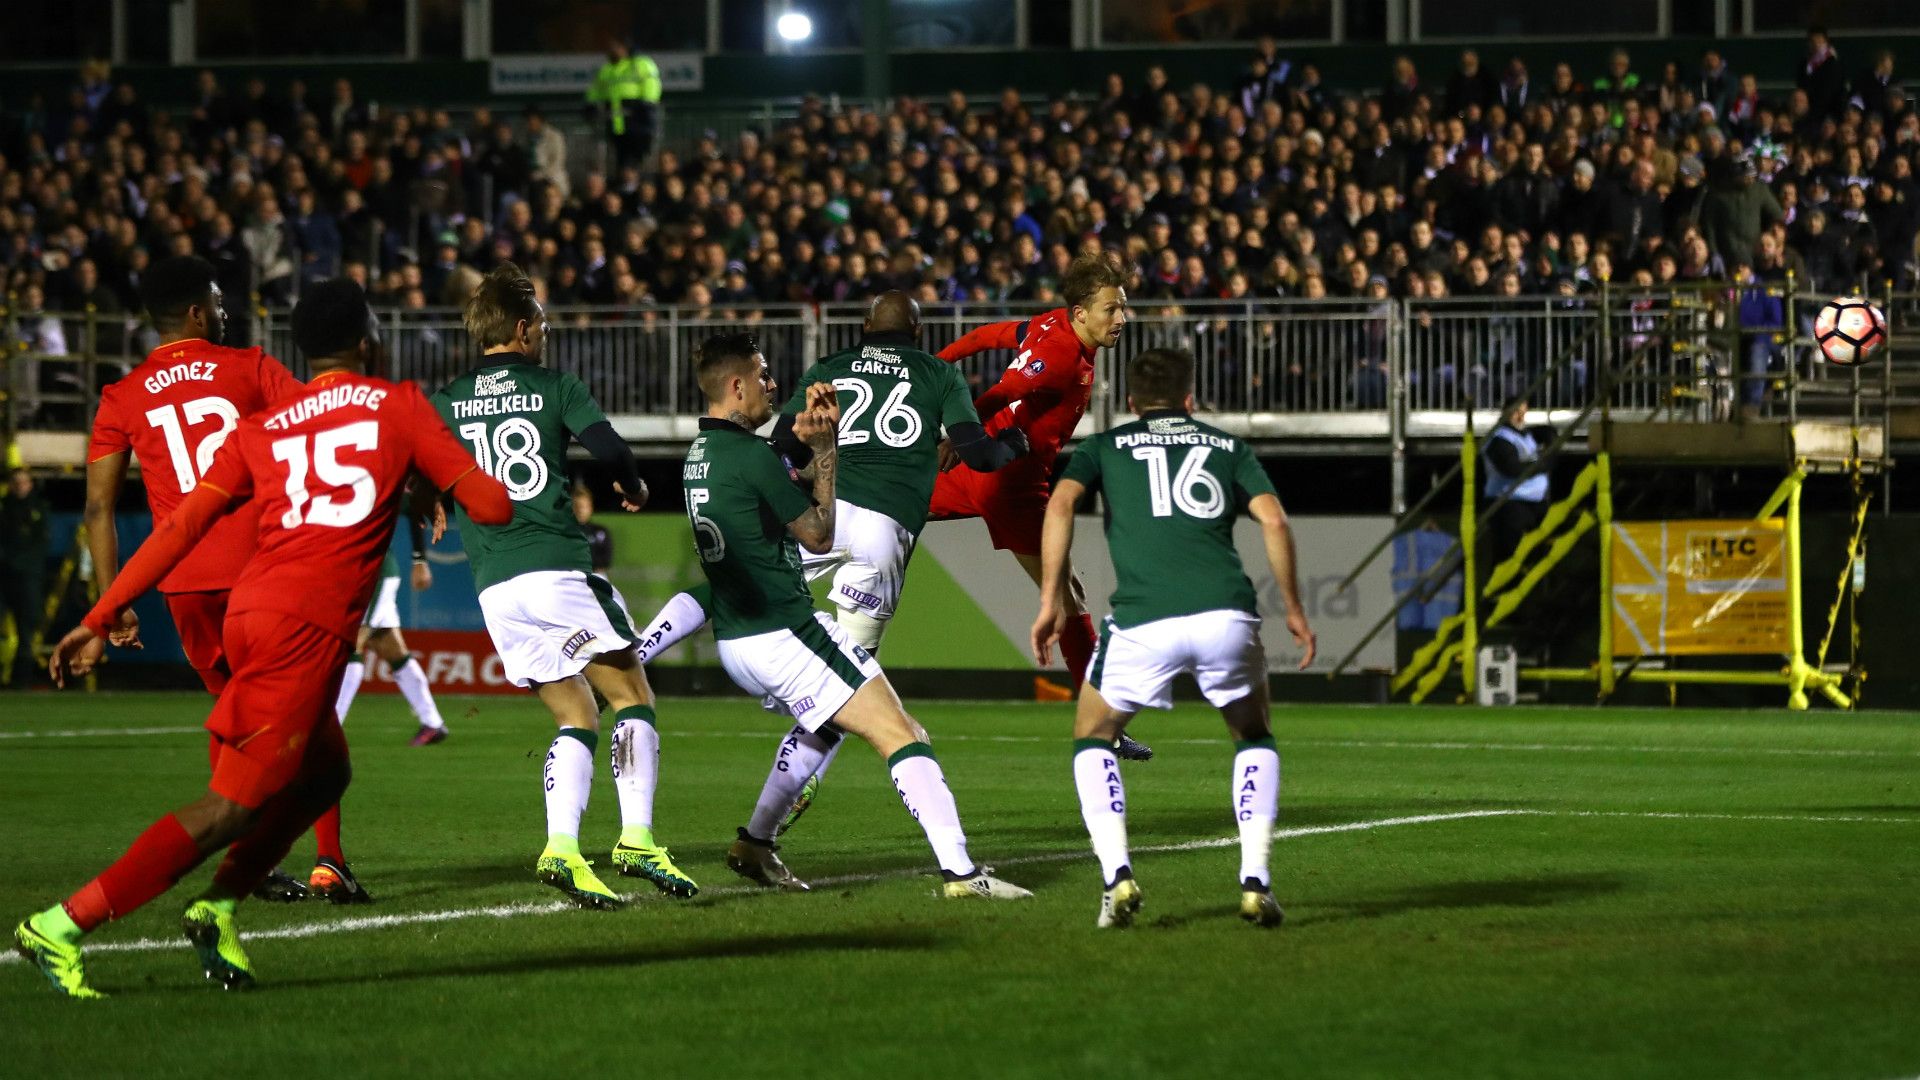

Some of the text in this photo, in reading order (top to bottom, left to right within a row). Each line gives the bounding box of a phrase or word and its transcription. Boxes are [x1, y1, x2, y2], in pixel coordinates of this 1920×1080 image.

[144, 361, 218, 394] GOMEZ
[476, 369, 509, 380] SUCCEED
[851, 360, 909, 380] GARITA
[451, 393, 544, 419] THRELKELD
[475, 385, 518, 396] UNIVERSITY
[832, 377, 922, 448] 26
[145, 396, 241, 494] 12
[459, 417, 549, 501] 18
[1115, 433, 1235, 453] PURRINGTON
[271, 420, 379, 529] 15
[1132, 446, 1226, 519] 16
[1710, 537, 1757, 559] LTC
[842, 585, 881, 608] TRIBUTE
[792, 697, 815, 718] BUTE
[778, 725, 806, 772] PAFC
[1103, 758, 1124, 813] PAFC
[1239, 765, 1259, 822] PAFC
